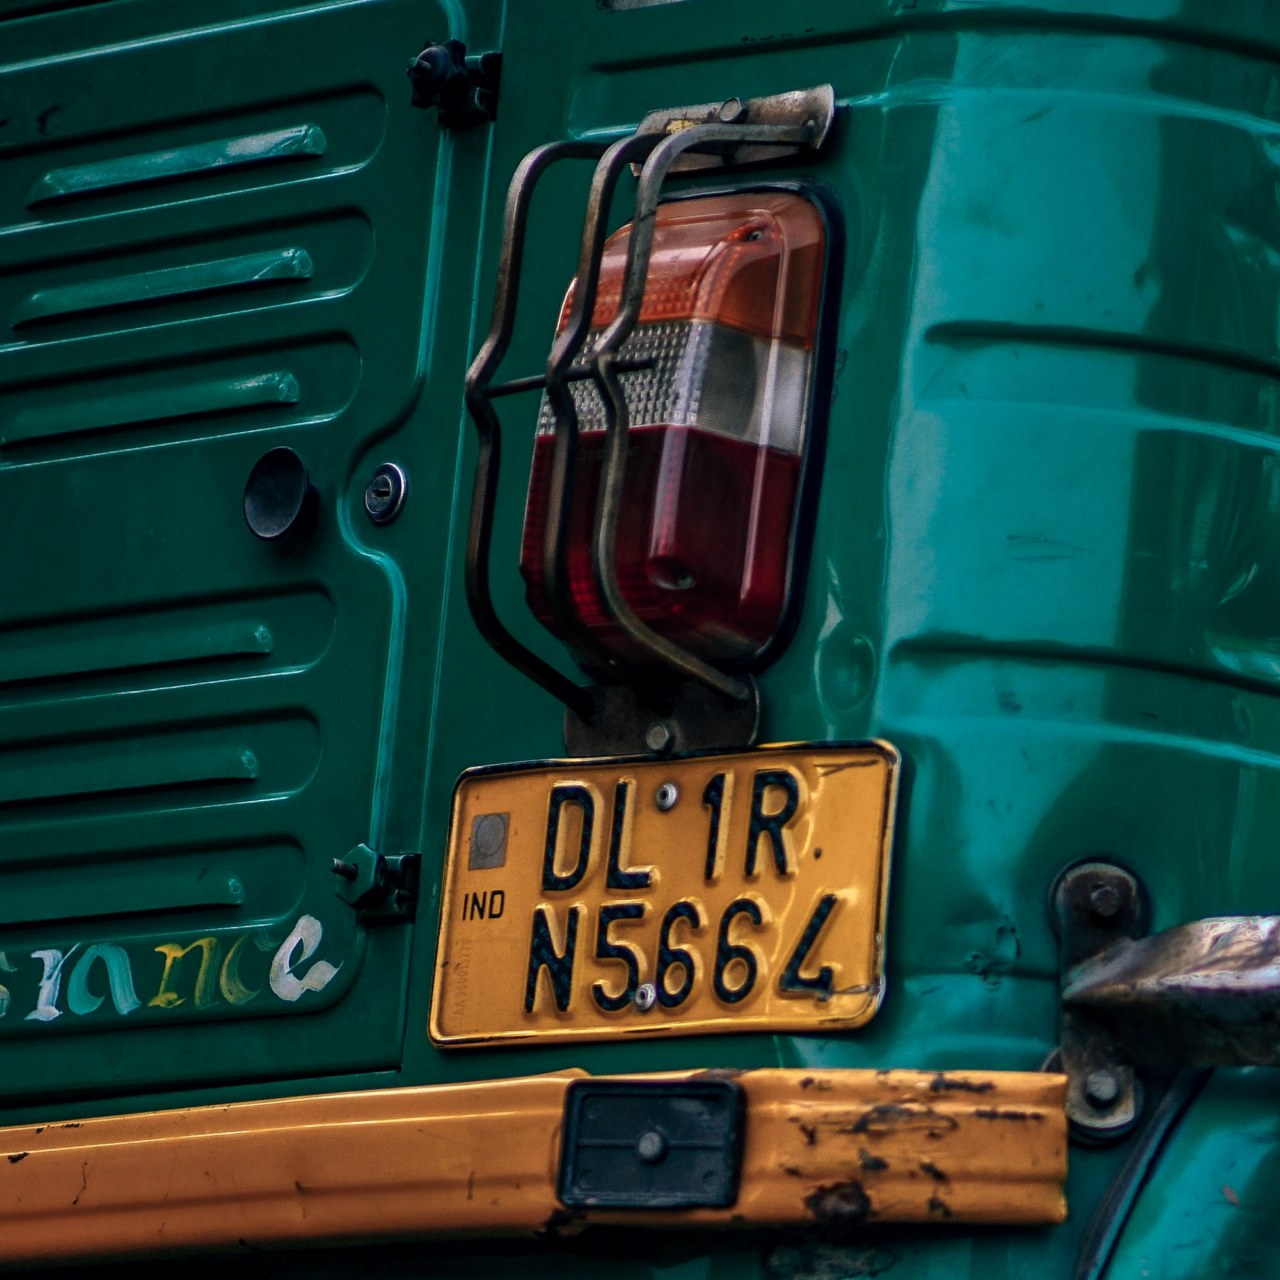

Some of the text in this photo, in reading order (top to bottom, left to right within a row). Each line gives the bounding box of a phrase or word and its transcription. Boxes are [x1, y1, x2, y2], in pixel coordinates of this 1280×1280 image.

[543, 769, 800, 892] DL 1R
[462, 889, 505, 921] IND
[524, 893, 841, 1014] N5664
[0, 914, 345, 1021] rance
